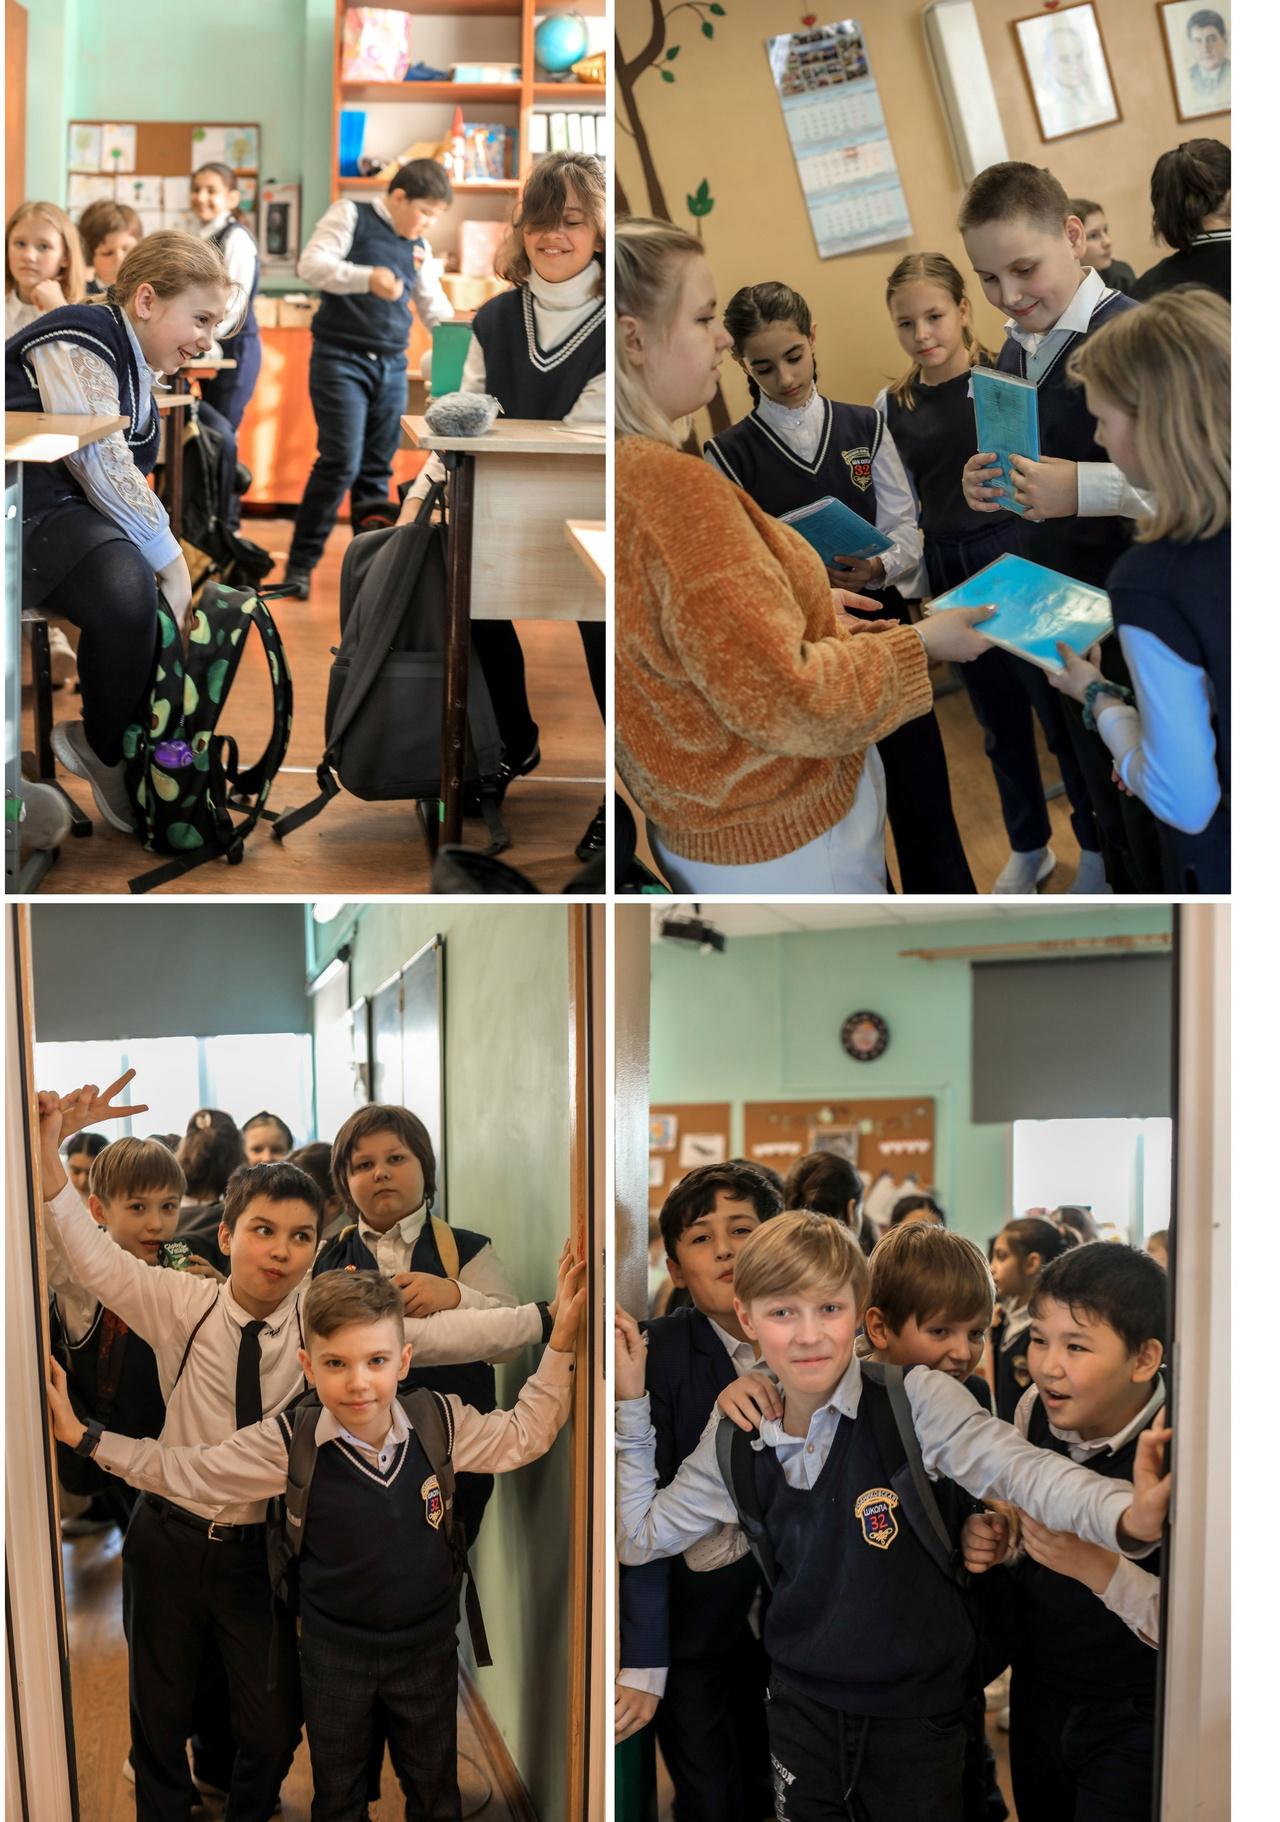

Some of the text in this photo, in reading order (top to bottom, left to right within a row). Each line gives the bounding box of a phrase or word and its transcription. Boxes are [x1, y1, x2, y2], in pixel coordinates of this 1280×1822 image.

[854, 464, 870, 476] 32
[430, 1497, 439, 1512] 32
[863, 1504, 888, 1516] ШКОЛА
[870, 1514, 888, 1530] 32
